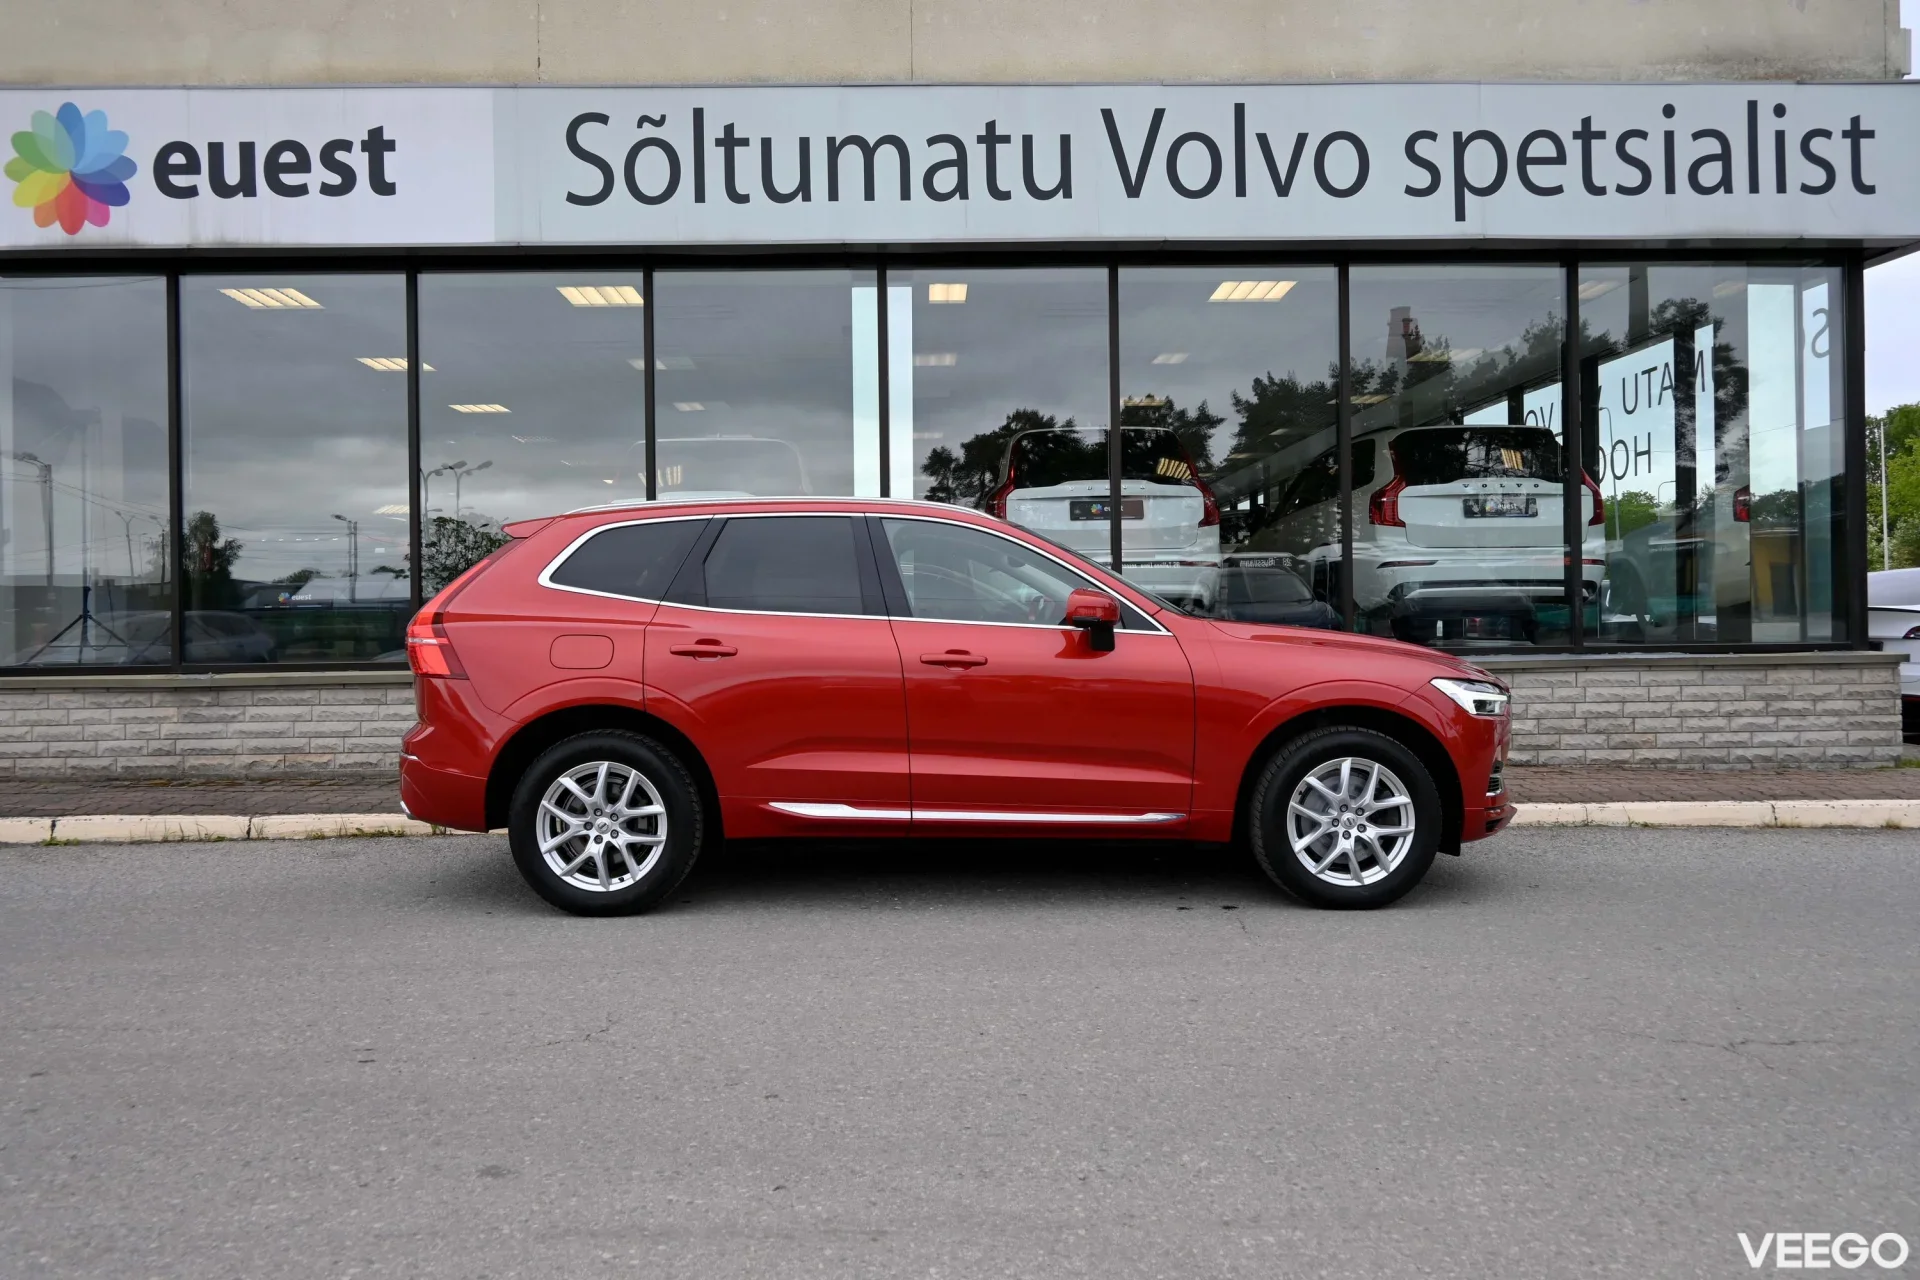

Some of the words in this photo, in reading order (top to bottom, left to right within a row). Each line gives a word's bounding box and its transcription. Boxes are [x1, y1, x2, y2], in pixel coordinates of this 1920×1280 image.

[152, 125, 397, 200] euest
[565, 107, 1073, 207] Sõltumatu
[1100, 102, 1370, 200] Volvo
[1404, 99, 1877, 222] spetsialist
